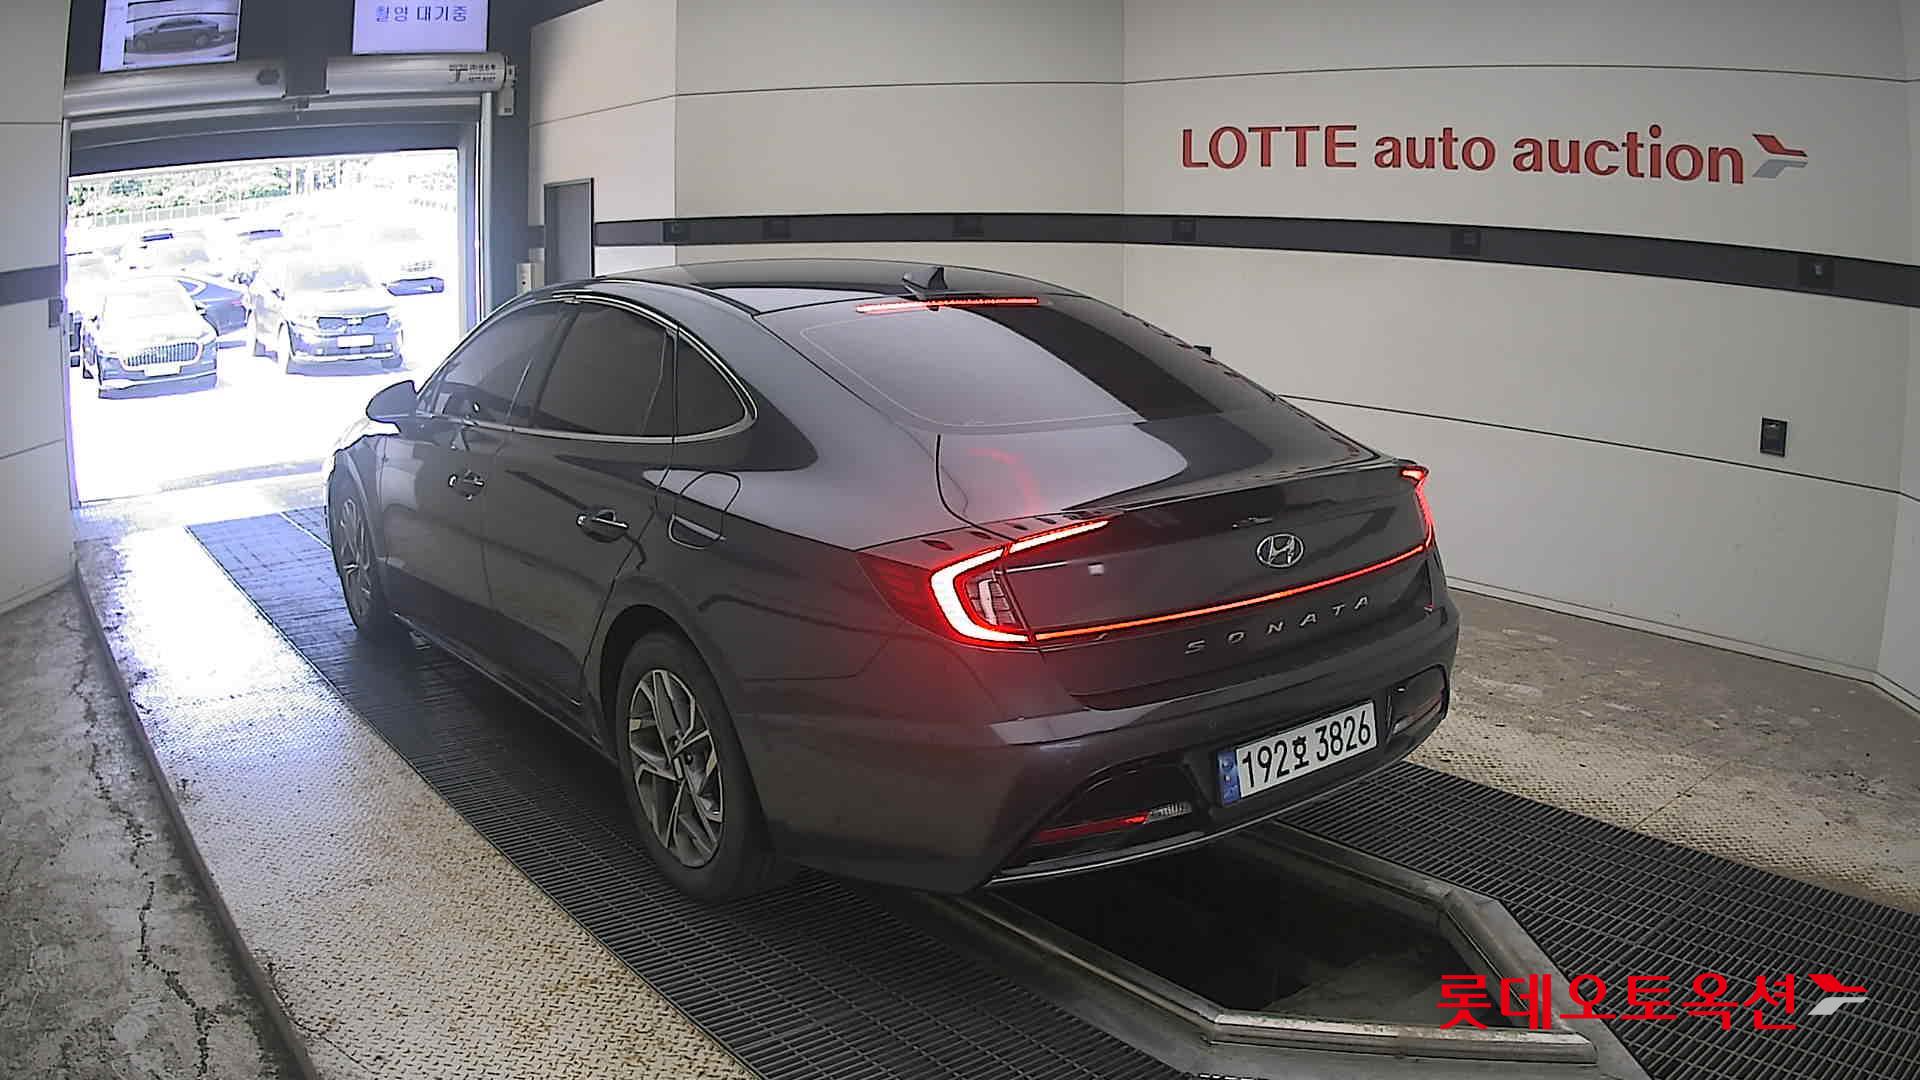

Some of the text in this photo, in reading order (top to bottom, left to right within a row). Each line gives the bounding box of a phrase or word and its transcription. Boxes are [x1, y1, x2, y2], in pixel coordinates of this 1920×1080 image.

[416, 5, 467, 22] 대기중
[1181, 124, 1744, 184] LOTTE auto auction
[1184, 596, 1369, 654] SONATA
[1242, 710, 1371, 788] 192호 3826
